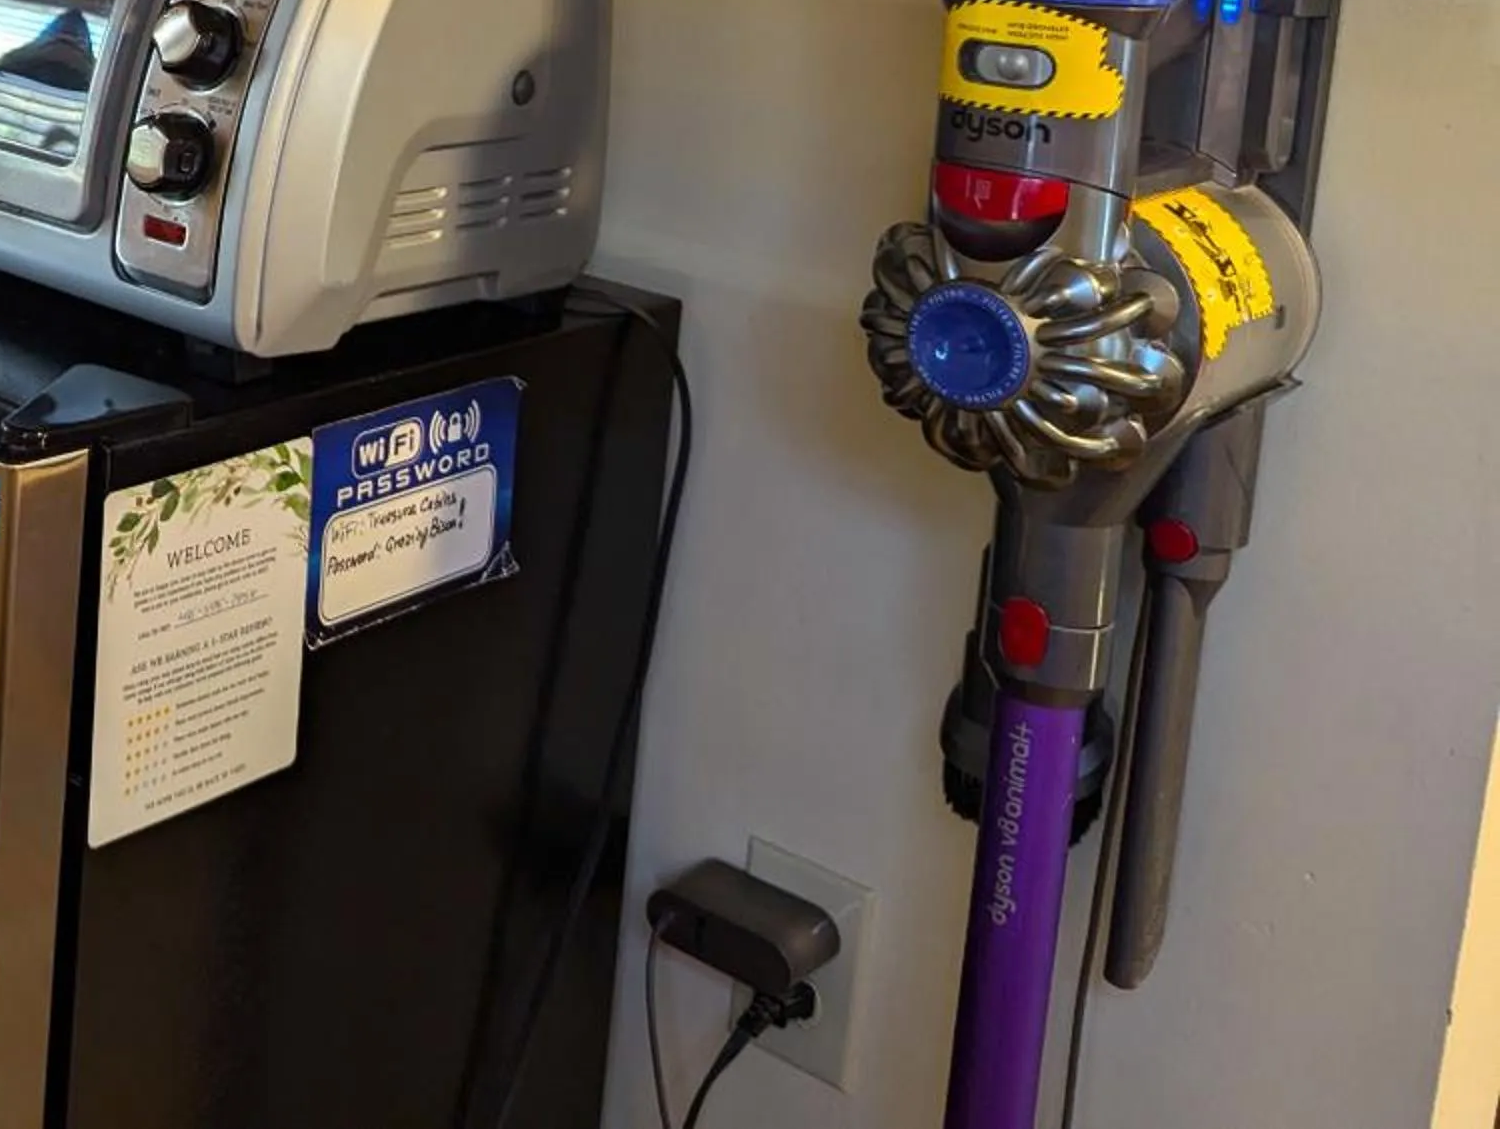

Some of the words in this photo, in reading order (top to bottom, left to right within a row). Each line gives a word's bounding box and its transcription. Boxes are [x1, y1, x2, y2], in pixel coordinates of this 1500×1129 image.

[950, 108, 1051, 143] dyson
[357, 428, 417, 468] WiFi
[336, 443, 490, 509] PASSWORD
[166, 528, 252, 569] WELCOME
[989, 854, 1017, 926] dyson
